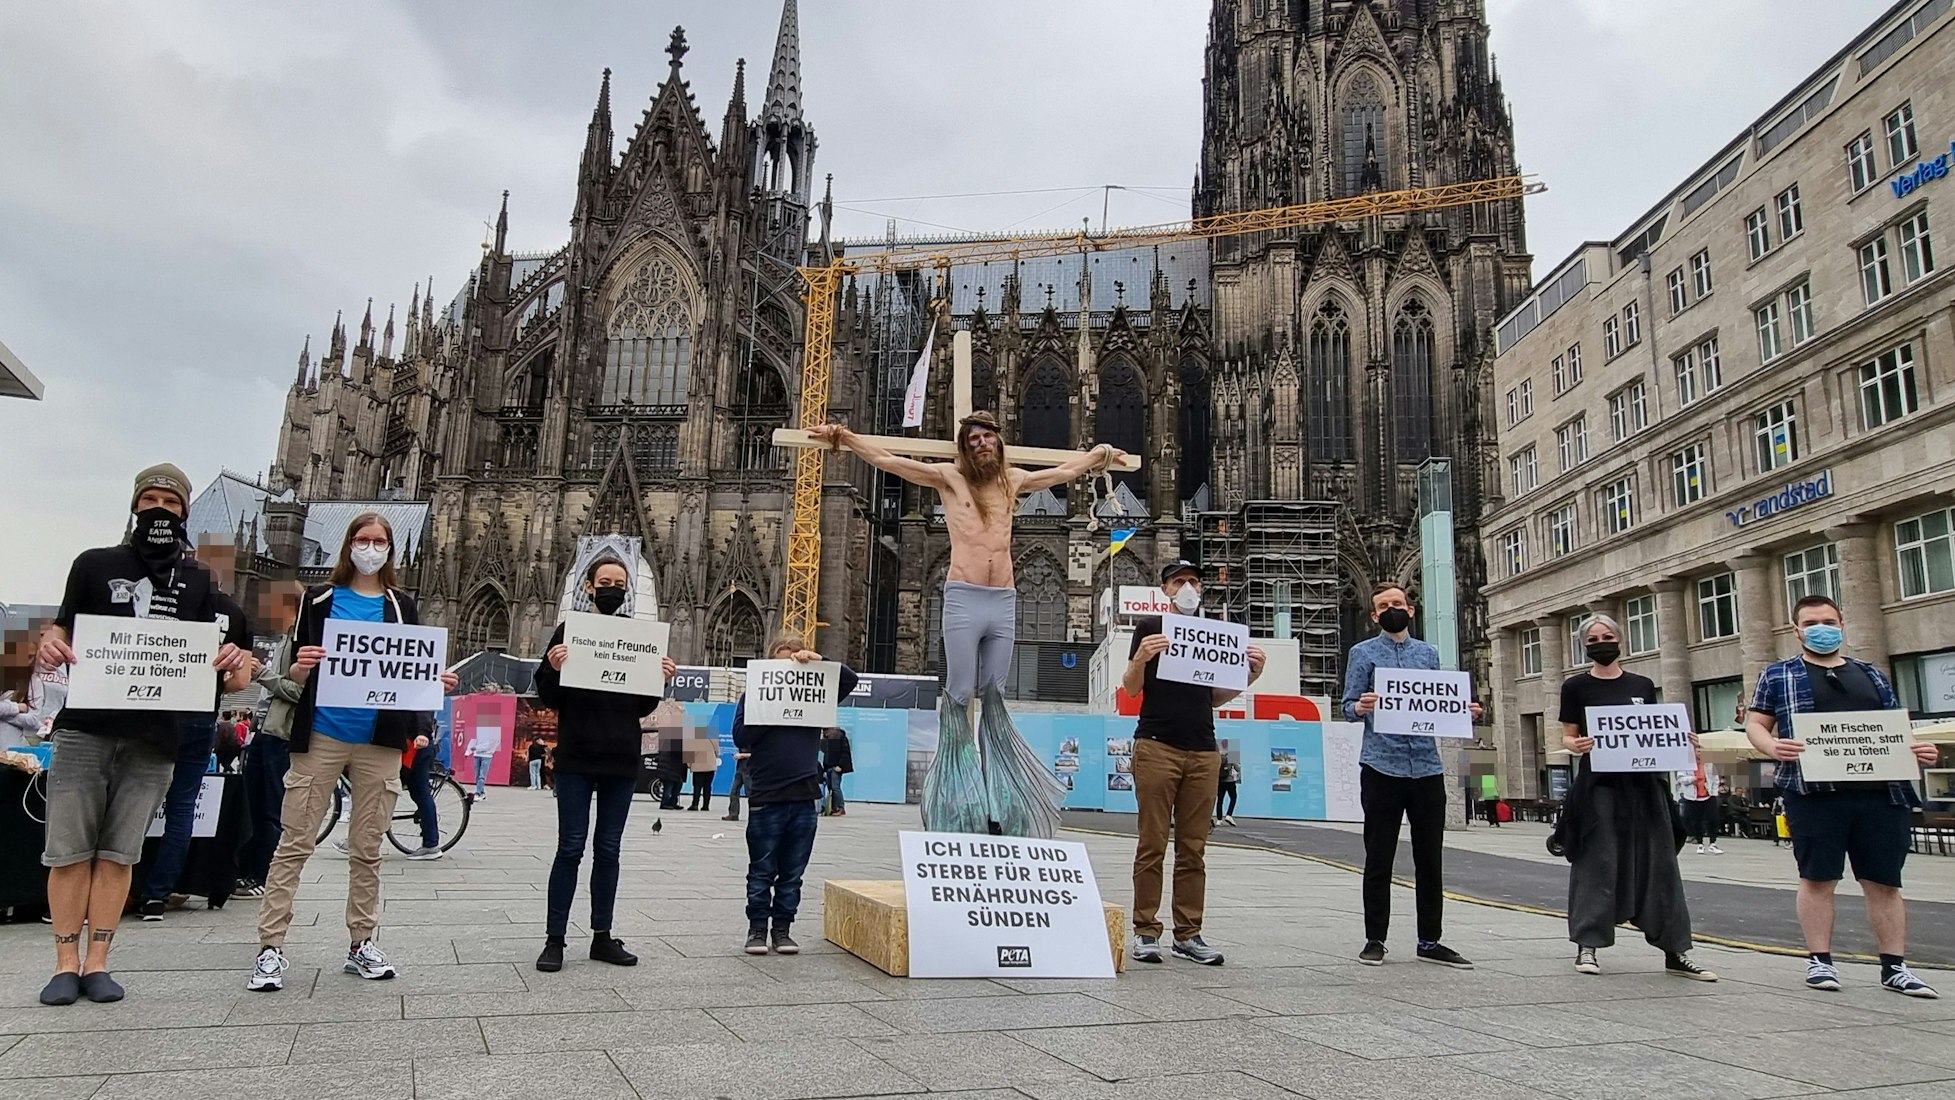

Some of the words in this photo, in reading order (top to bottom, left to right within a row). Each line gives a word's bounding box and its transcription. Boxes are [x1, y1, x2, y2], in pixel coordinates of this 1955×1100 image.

[1891, 154, 1948, 198] Verlag
[1753, 469, 1832, 519] randstad
[110, 632, 132, 645] Mit
[136, 633, 187, 648] Fischen
[336, 633, 435, 658] FISCHEN
[572, 636, 596, 647] Fische
[599, 639, 614, 649] sind
[617, 639, 660, 655] Freunde,
[1174, 626, 1239, 649] FISCHEN
[85, 648, 173, 664] schwimmen,
[178, 652, 207, 664] statt
[594, 651, 609, 660] kein
[612, 652, 637, 663] Essen!
[1062, 653, 1077, 668] U
[1165, 643, 1188, 658] IST
[1192, 646, 1245, 667] MORD!
[105, 663, 125, 675] sie
[130, 666, 145, 676] zu
[150, 664, 187, 678] töten!
[327, 657, 372, 677] TUT
[379, 660, 438, 682] WEH!
[761, 670, 825, 687] FISCHEN
[758, 687, 784, 701] TUT
[790, 687, 826, 704] WEH!
[1387, 680, 1458, 697] FISCHEN
[1379, 697, 1403, 711] IST
[1408, 698, 1466, 714] MORD!
[1597, 714, 1679, 731] FISCHEN
[1820, 723, 1837, 734] Mit
[1841, 723, 1884, 733] Fischen
[1593, 734, 1630, 749] TUT
[1635, 732, 1688, 748] WEH!
[1805, 735, 1876, 746] schwimmen,
[1879, 734, 1904, 744] statt
[1823, 747, 1840, 757] sie
[1843, 748, 1856, 756] zu
[1859, 745, 1890, 756] töten!
[924, 841, 962, 857] ICH
[970, 842, 1022, 859] LEIDE
[1027, 846, 1068, 862] UND
[916, 863, 987, 880] STERBE
[995, 862, 1031, 882] FÜR
[1038, 867, 1084, 884] EURE
[931, 883, 1078, 906] ERNÄHRUNGS-
[967, 906, 1051, 928] SÜNDEN
